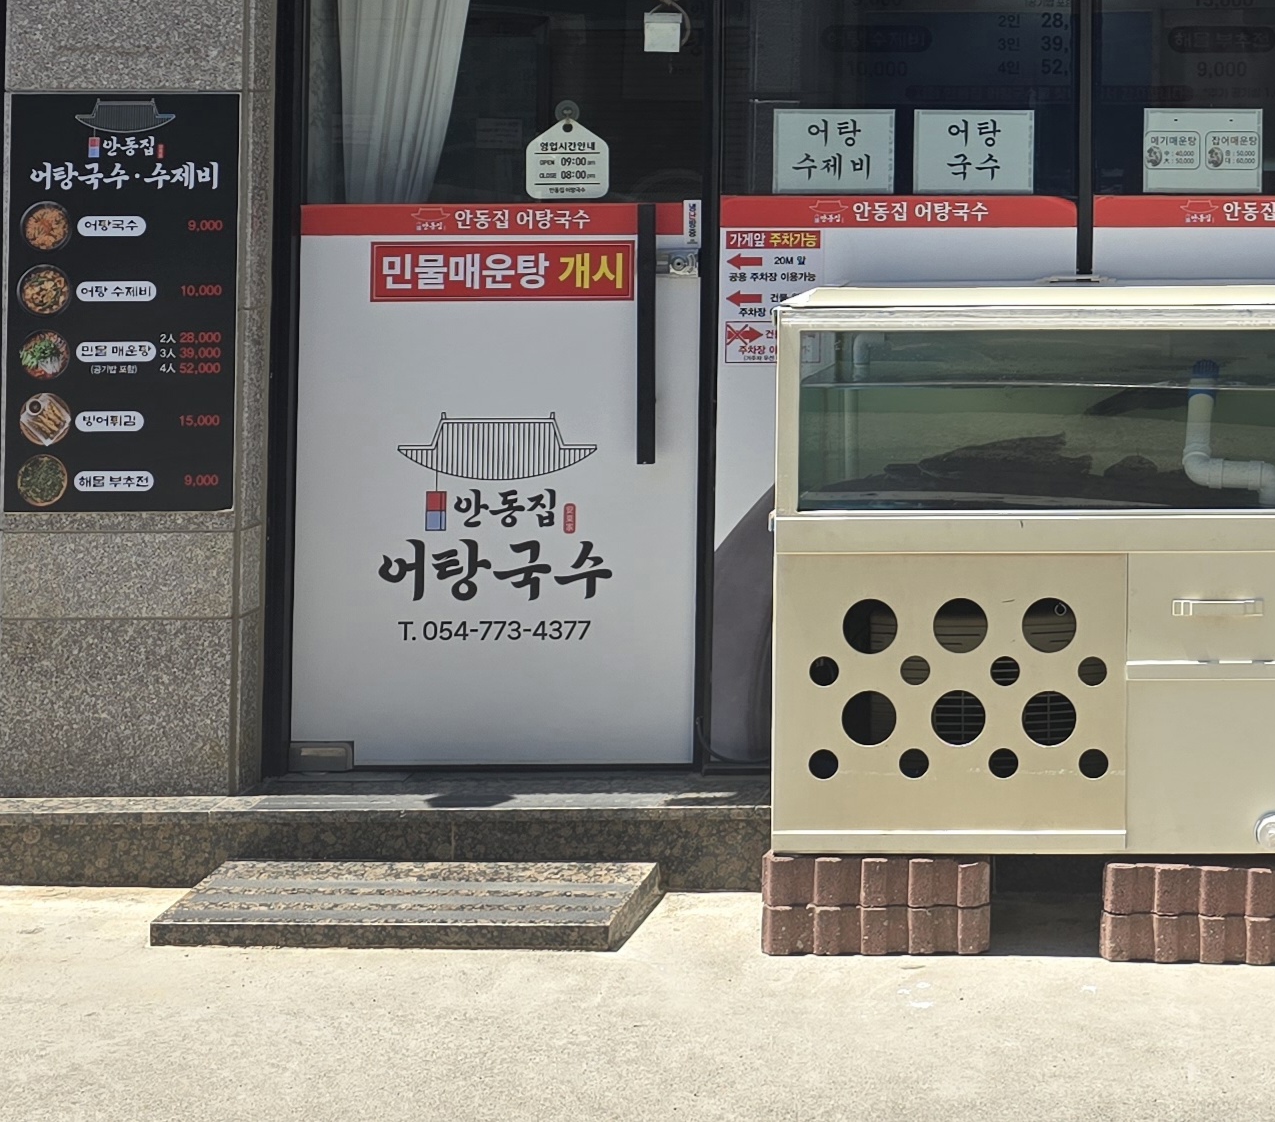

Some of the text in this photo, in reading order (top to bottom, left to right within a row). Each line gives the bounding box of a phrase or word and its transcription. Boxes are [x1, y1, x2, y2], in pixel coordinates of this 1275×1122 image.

[807, 118, 862, 148] 어탕
[947, 118, 1002, 148] 어탕
[102, 135, 155, 156] 안동집
[540, 141, 596, 152] 영업시간안내
[560, 157, 587, 166] 09:00
[791, 153, 872, 182] 수제비
[946, 153, 1001, 182] 국수
[560, 170, 587, 180] 08:00
[454, 209, 591, 229] 안동집 어탕국수
[853, 202, 989, 222] 안동집 어탕국수
[84, 219, 223, 232] 어탕국수 9,000
[729, 232, 818, 248] 가게앞 주차가능
[774, 256, 794, 266] 20M
[381, 252, 624, 290] 민물매운탕 개시
[728, 272, 817, 282] 공용 주차장 이용가능
[81, 285, 108, 298] 어탕
[111, 285, 151, 298] 수제비
[738, 307, 767, 318] 주차장
[179, 331, 222, 345] 28,000
[111, 345, 152, 357] 매운탕
[179, 347, 222, 360] 39,000
[738, 345, 766, 355] 주차장
[179, 362, 222, 375] 52,000
[82, 414, 220, 427] 빙어튀김 15,000
[109, 475, 149, 488] 부추전
[184, 474, 219, 488] 9,000
[453, 488, 557, 528] 안동집
[378, 538, 613, 602] 어탕국수
[398, 620, 592, 641] T. 054-773-4377
